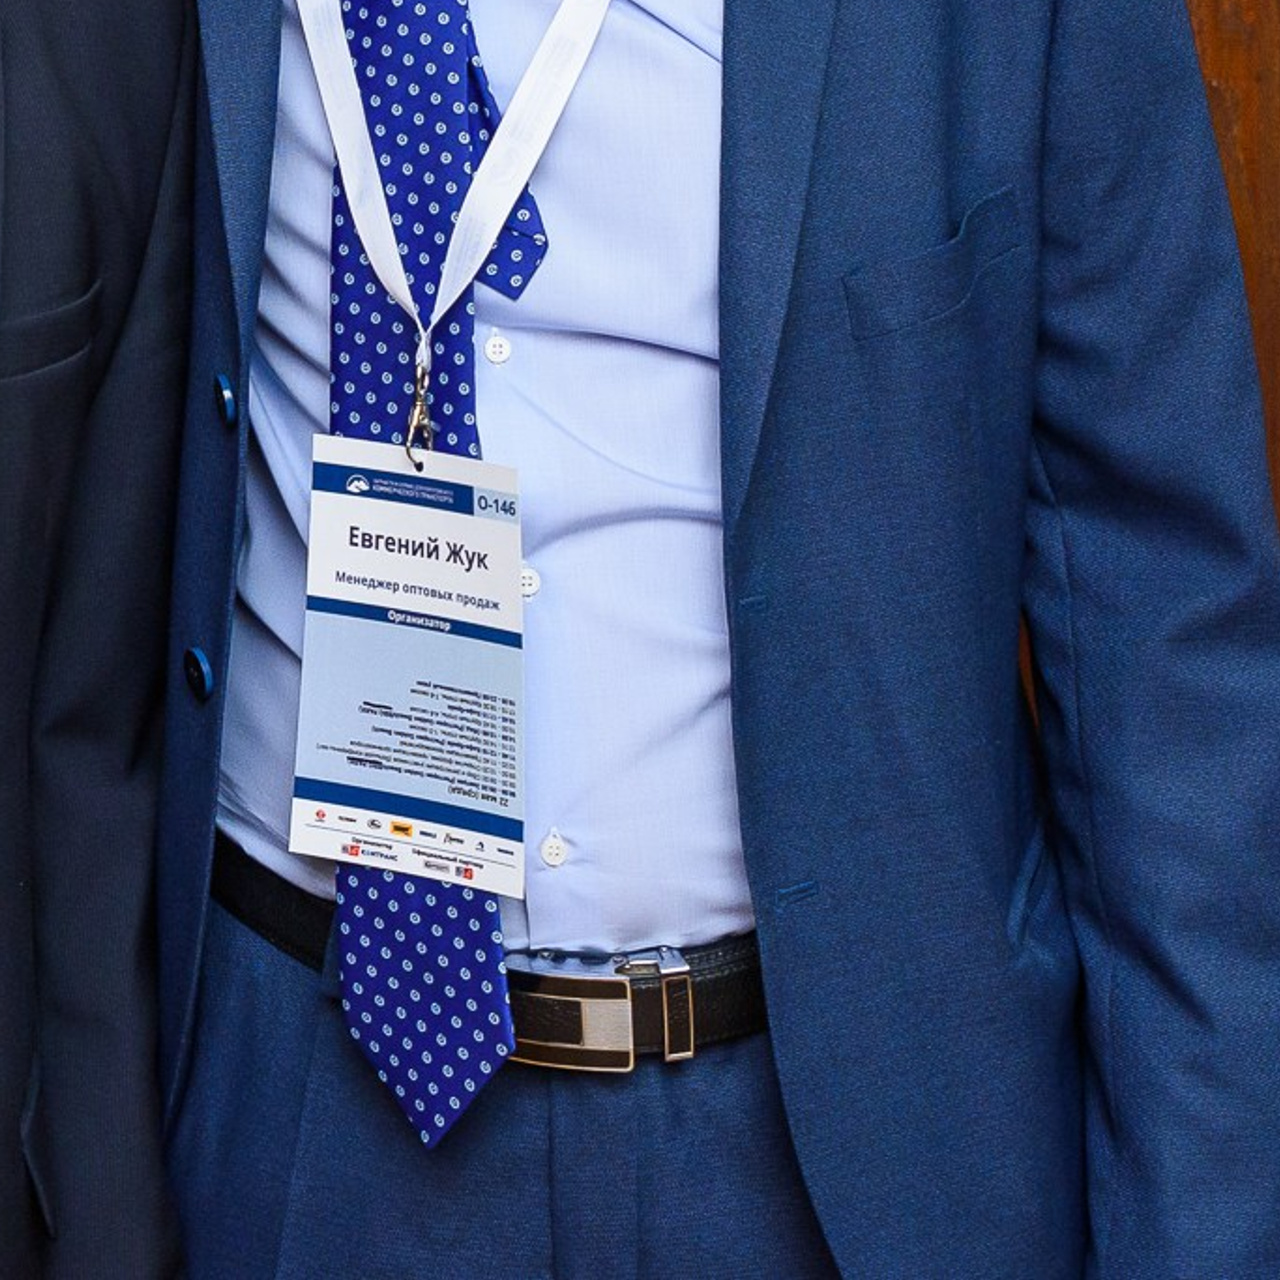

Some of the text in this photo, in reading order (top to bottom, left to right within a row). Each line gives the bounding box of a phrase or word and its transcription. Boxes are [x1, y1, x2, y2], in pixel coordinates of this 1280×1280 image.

[349, 525, 489, 572] Евгений Жук
[335, 571, 500, 611] Менеджер оптовых продаж
[387, 609, 451, 632] Организатор
